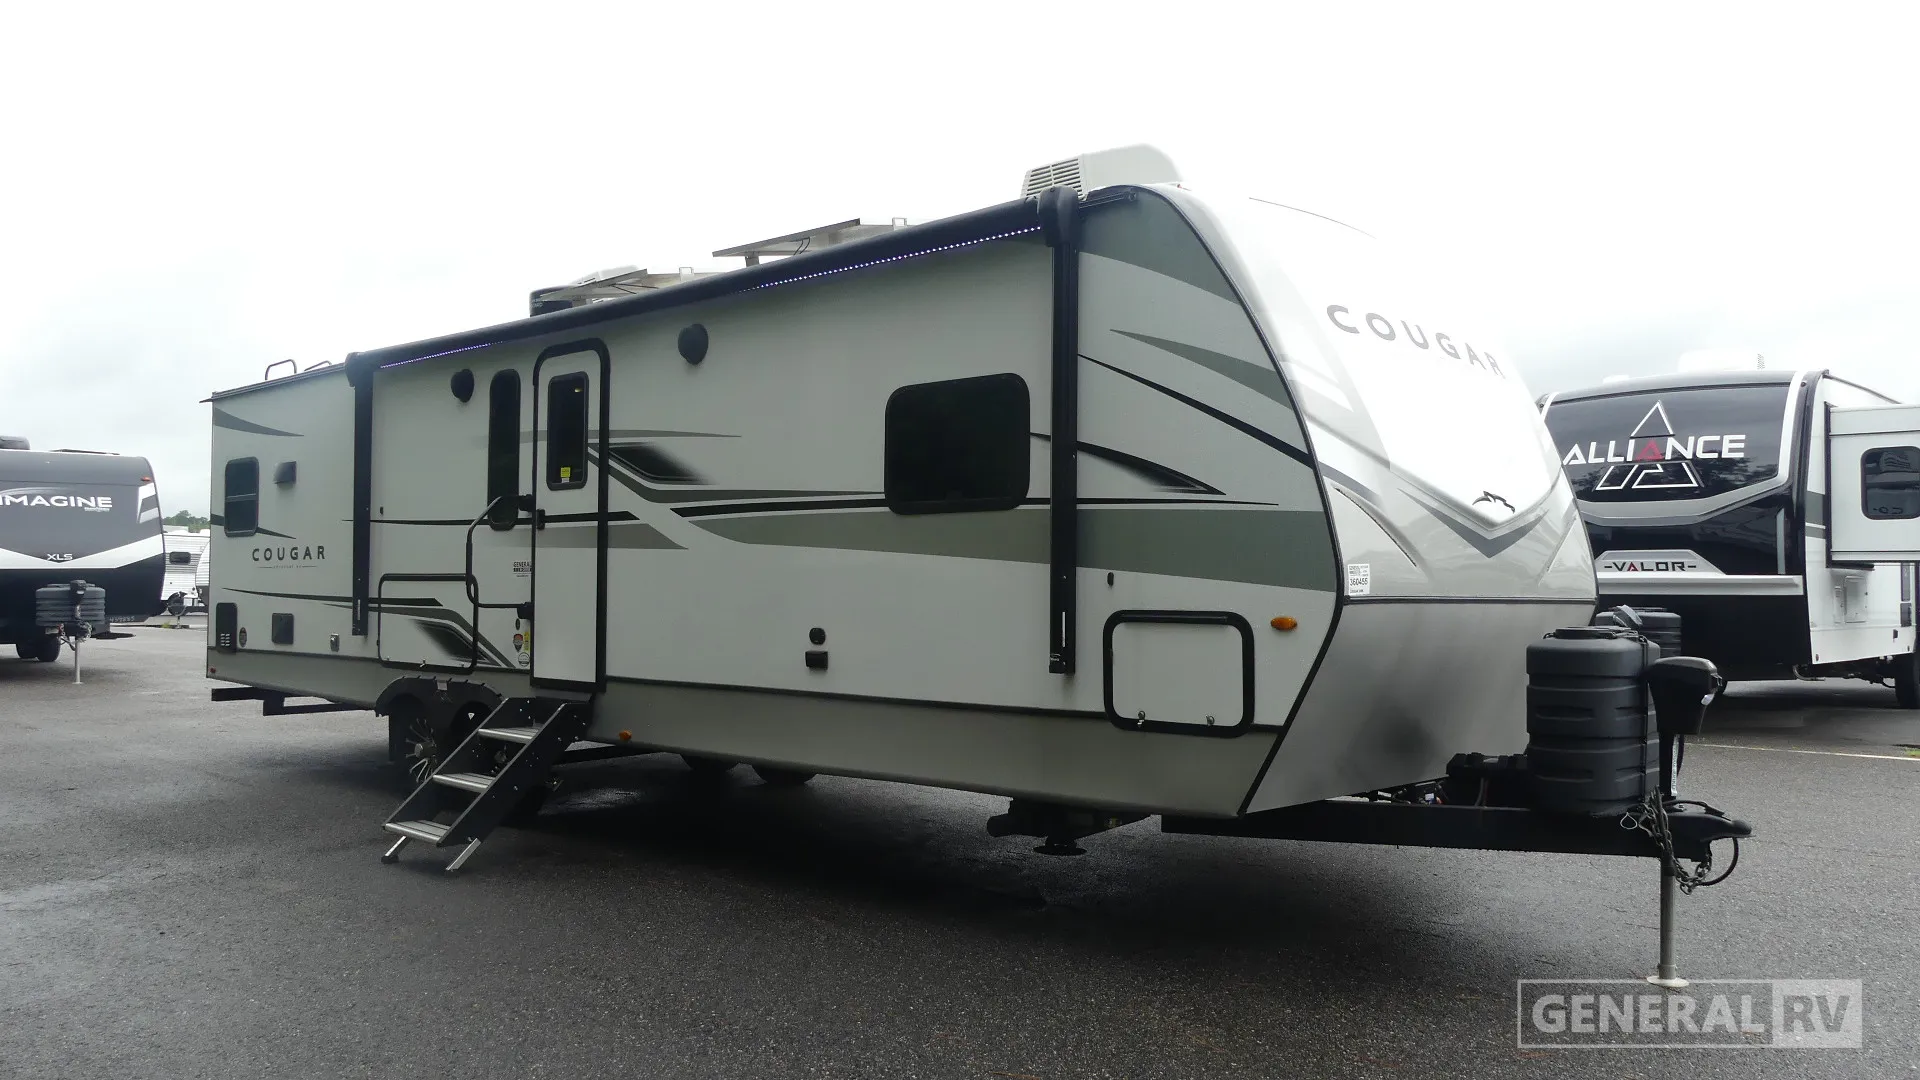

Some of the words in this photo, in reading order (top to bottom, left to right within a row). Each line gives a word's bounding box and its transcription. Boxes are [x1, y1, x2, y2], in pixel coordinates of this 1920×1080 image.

[1327, 304, 1506, 380] COUGAR
[1562, 434, 1746, 466] ALLIANCE
[47, 553, 73, 561] XLS
[252, 545, 325, 561] COUGAR
